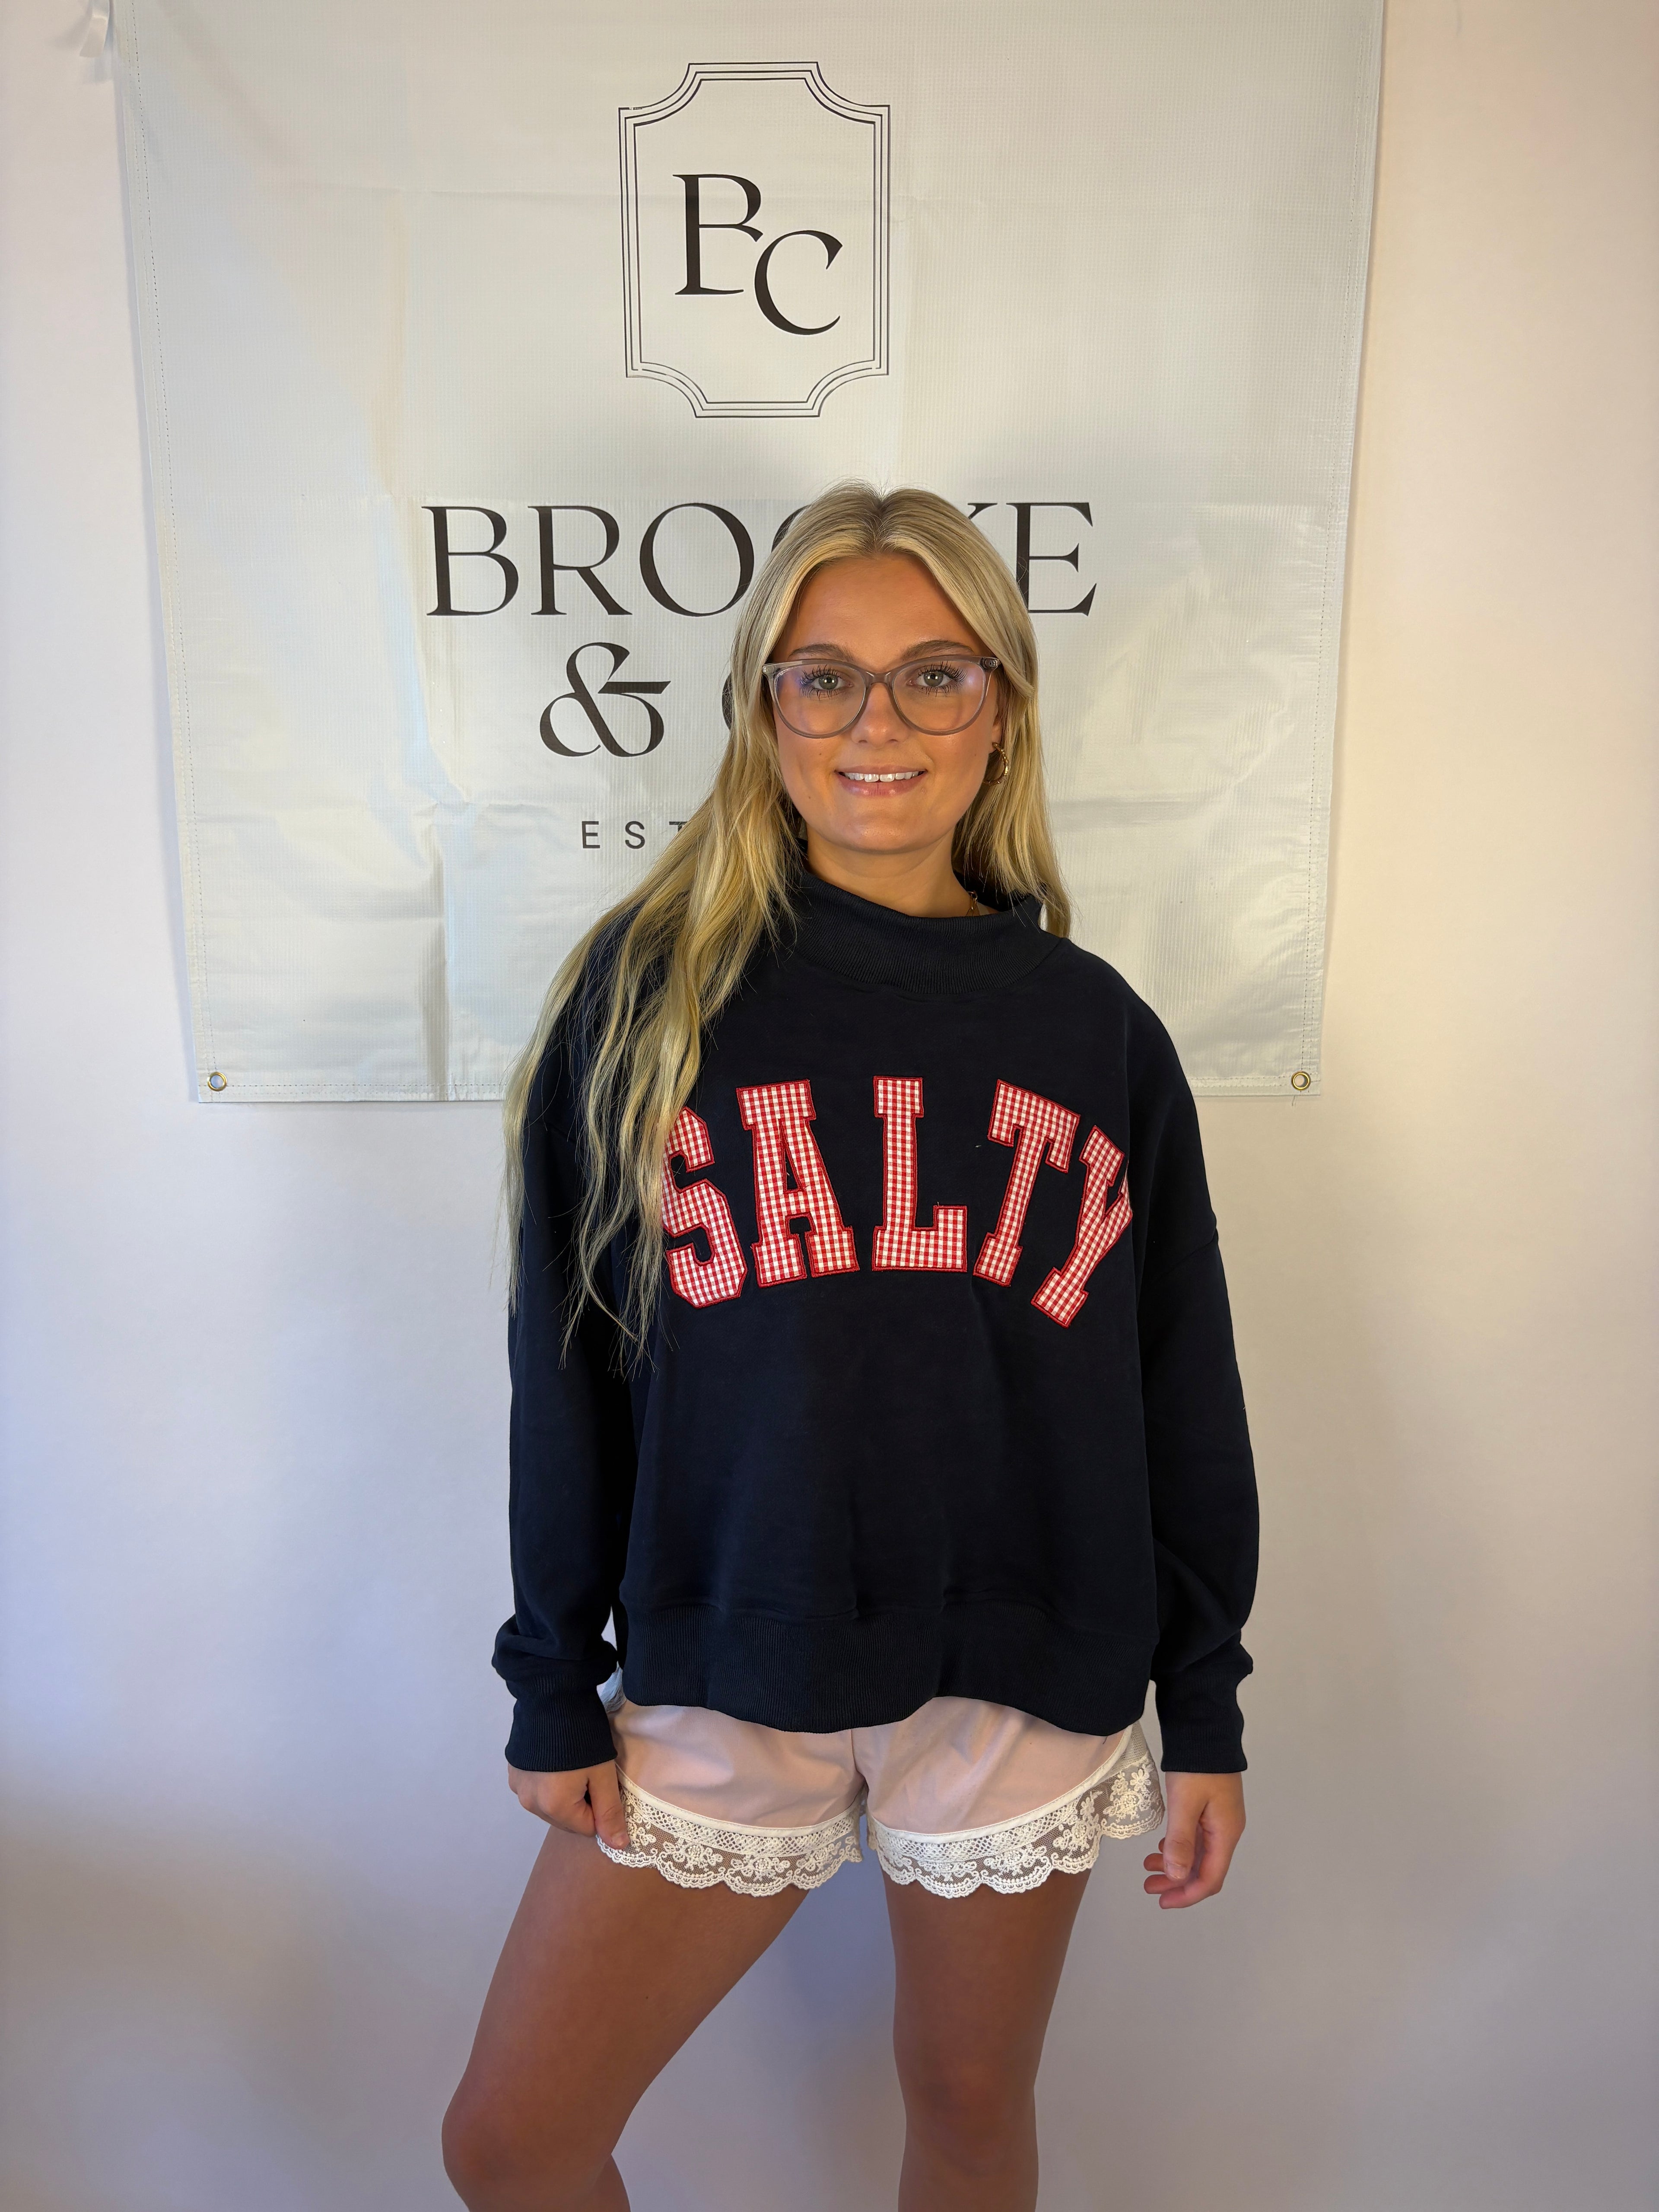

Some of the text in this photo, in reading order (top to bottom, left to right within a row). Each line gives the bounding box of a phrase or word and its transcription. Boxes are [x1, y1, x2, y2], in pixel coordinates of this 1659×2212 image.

[672, 174, 843, 335] BC
[421, 502, 1097, 617] BROE
[540, 642, 671, 757] &
[661, 1075, 1133, 1328] SALTY
